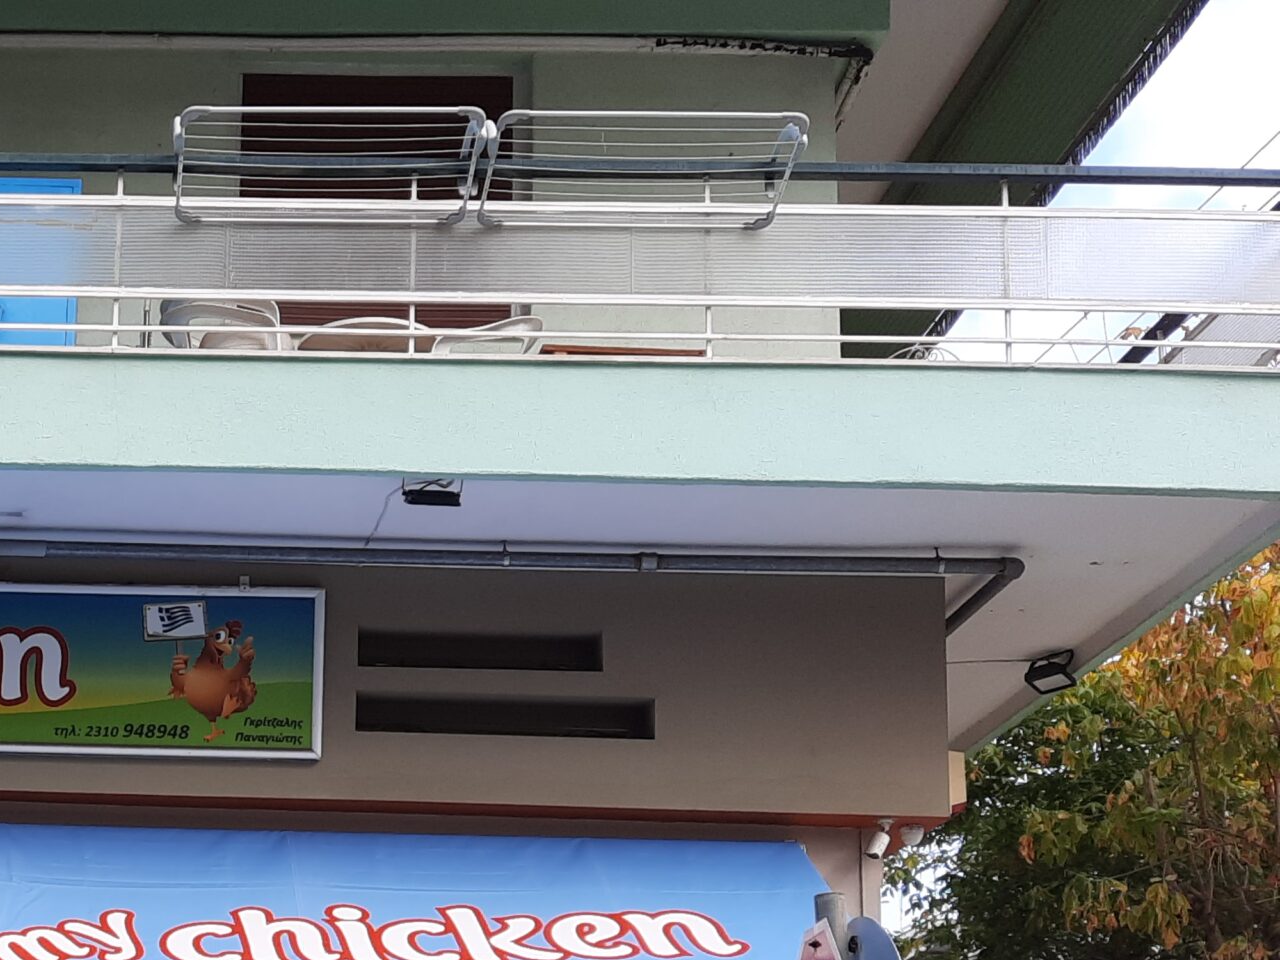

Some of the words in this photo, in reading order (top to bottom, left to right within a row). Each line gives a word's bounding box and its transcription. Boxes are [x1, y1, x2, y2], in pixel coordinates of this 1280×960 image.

[243, 716, 303, 729] Γκρίτζαλης
[53, 725, 81, 738] τηλ:
[85, 725, 119, 738] 2310
[122, 723, 190, 740] 948948
[235, 731, 303, 745] Παναγιώτης
